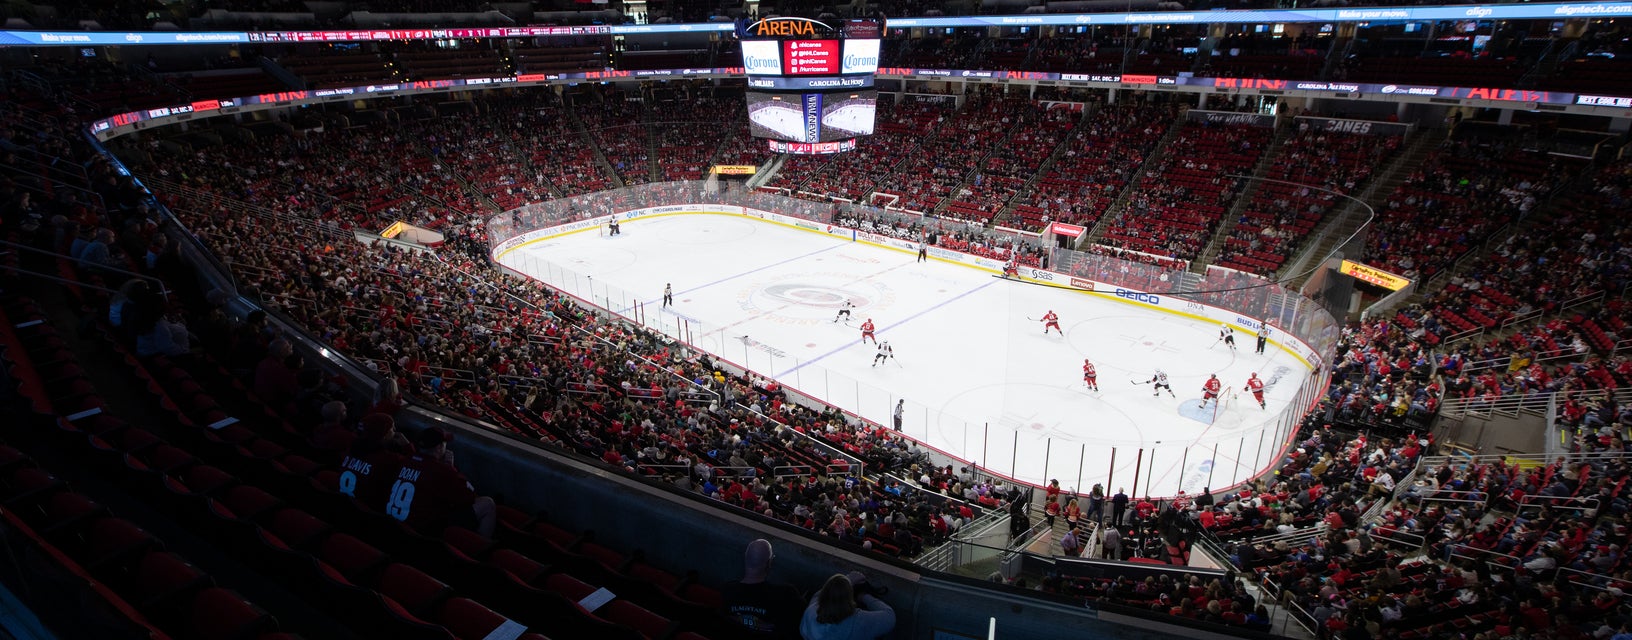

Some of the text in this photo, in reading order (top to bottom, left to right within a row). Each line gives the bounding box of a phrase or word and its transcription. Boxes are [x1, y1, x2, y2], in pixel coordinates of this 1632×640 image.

[1361, 11, 1381, 19] your
[1466, 7, 1493, 18] align
[757, 17, 815, 36] ARENA
[745, 56, 779, 72] Corona
[844, 54, 876, 71] Corona
[809, 79, 841, 87] CAROLINA
[1325, 120, 1372, 135] CANES
[1038, 270, 1053, 281] sas
[1072, 279, 1093, 289] Lenovo
[1116, 288, 1159, 304] GEICO
[1236, 316, 1253, 328] BUD
[399, 467, 421, 481] DOAN
[386, 479, 415, 521] 19
